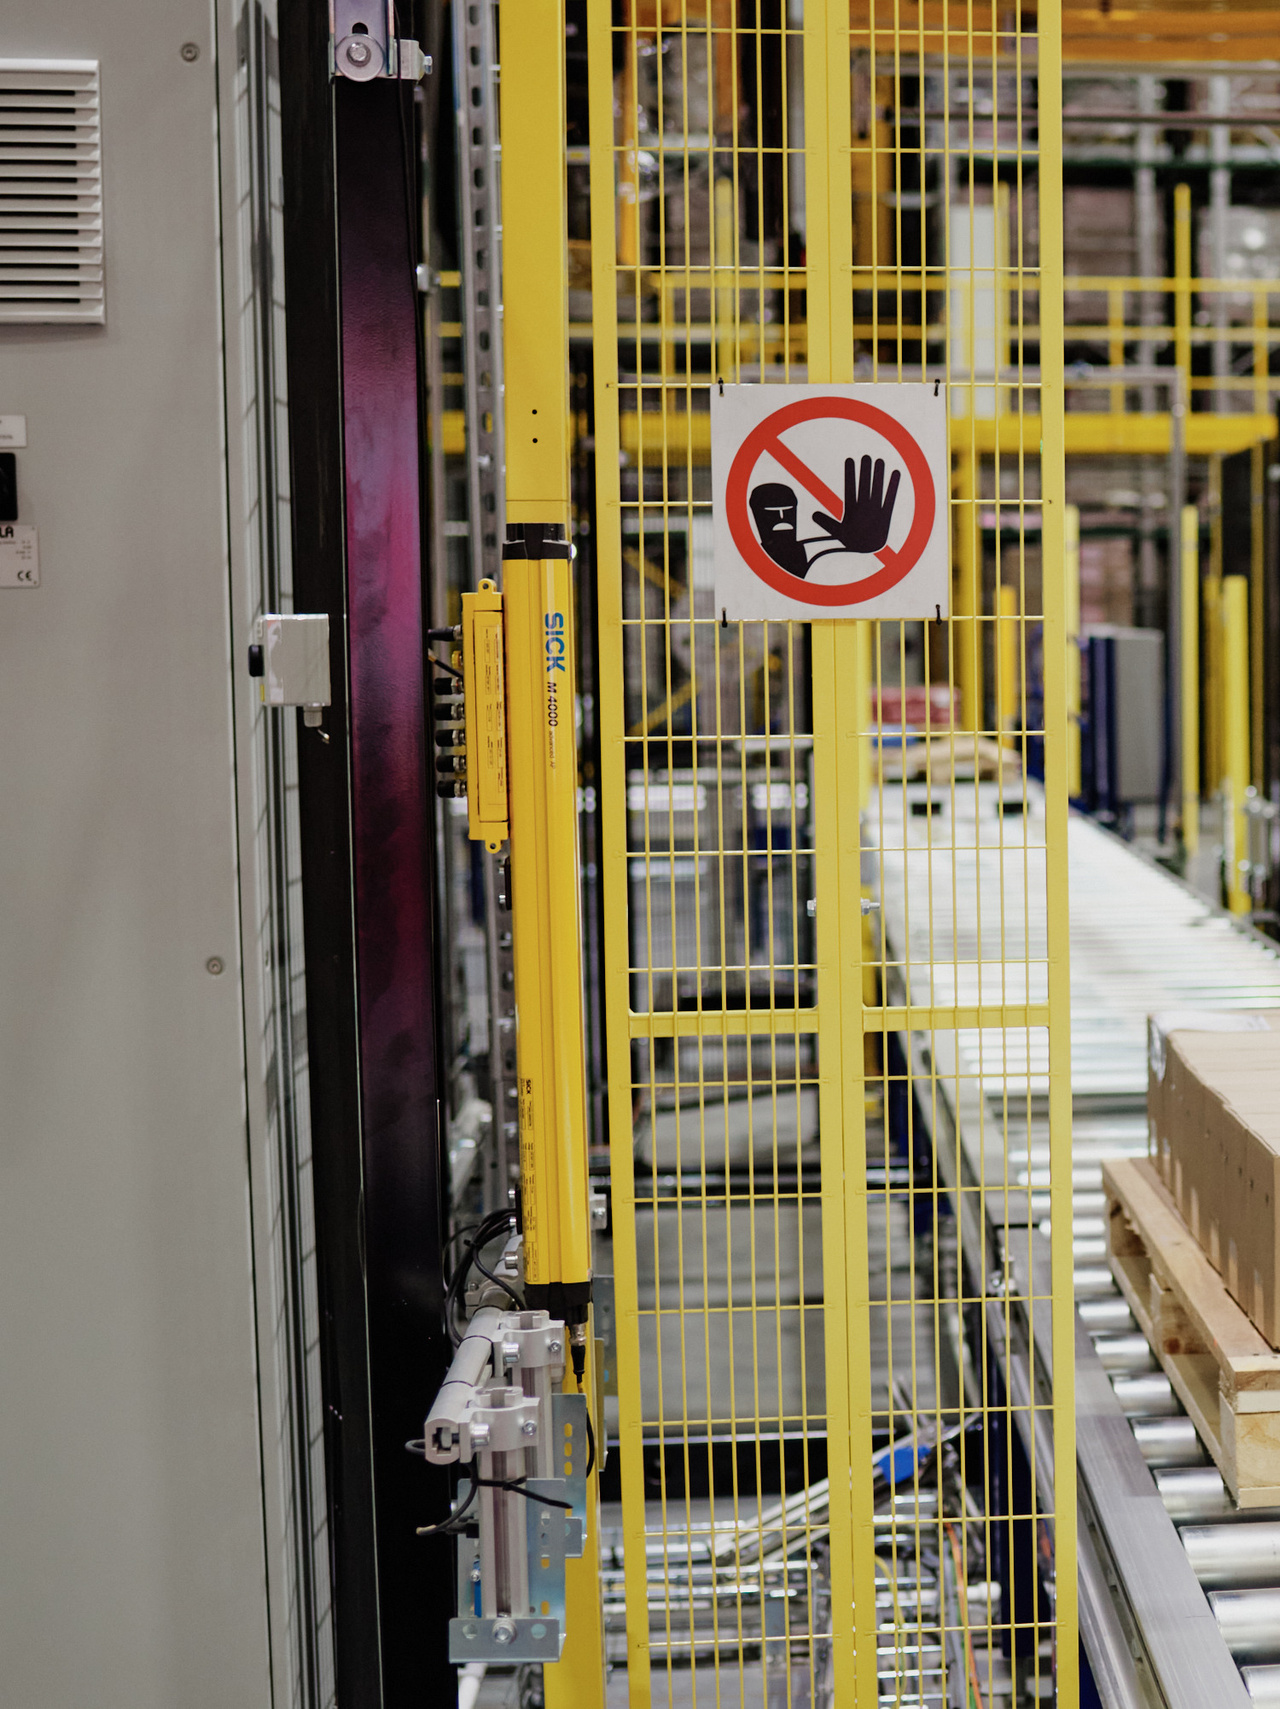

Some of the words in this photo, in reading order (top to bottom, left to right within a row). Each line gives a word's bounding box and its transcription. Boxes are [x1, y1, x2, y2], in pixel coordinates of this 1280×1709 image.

[545, 612, 565, 672] SICK
[547, 681, 557, 693] M
[548, 695, 558, 727] 4000
